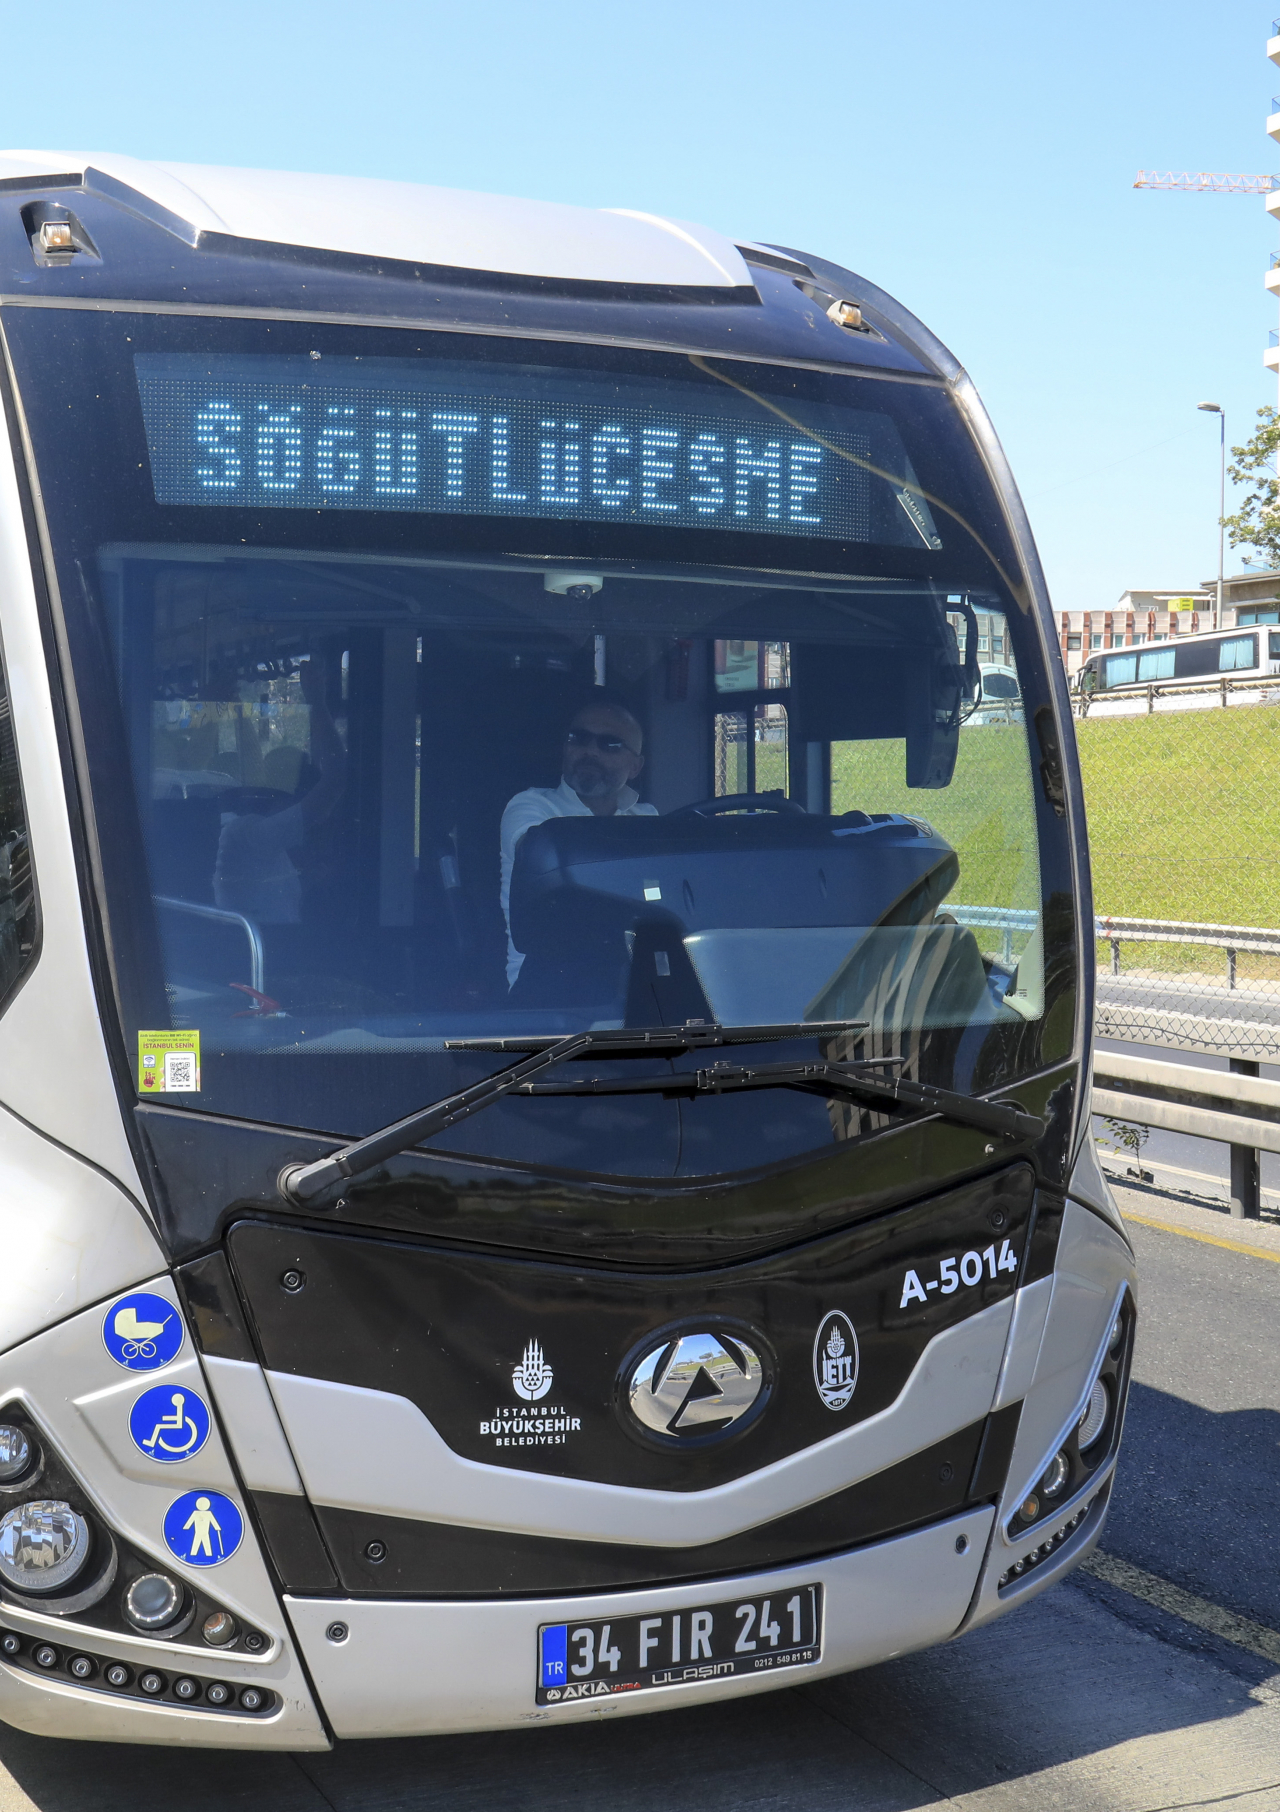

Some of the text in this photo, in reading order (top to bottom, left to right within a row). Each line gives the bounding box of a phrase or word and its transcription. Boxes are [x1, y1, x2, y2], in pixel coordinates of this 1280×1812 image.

[900, 1239, 1018, 1308] A-5014
[496, 1406, 566, 1417] İSTANBUL
[480, 1416, 581, 1434] BÜYÜKŞEHİR
[495, 1433, 566, 1447] BELEDİYESİ
[571, 1595, 801, 1677] 34 FIR 241
[546, 1661, 564, 1675] TR
[754, 1650, 813, 1668] 0212 549 81 15
[562, 1681, 610, 1700] AKIA
[651, 1661, 735, 1685] ULAŞIM
